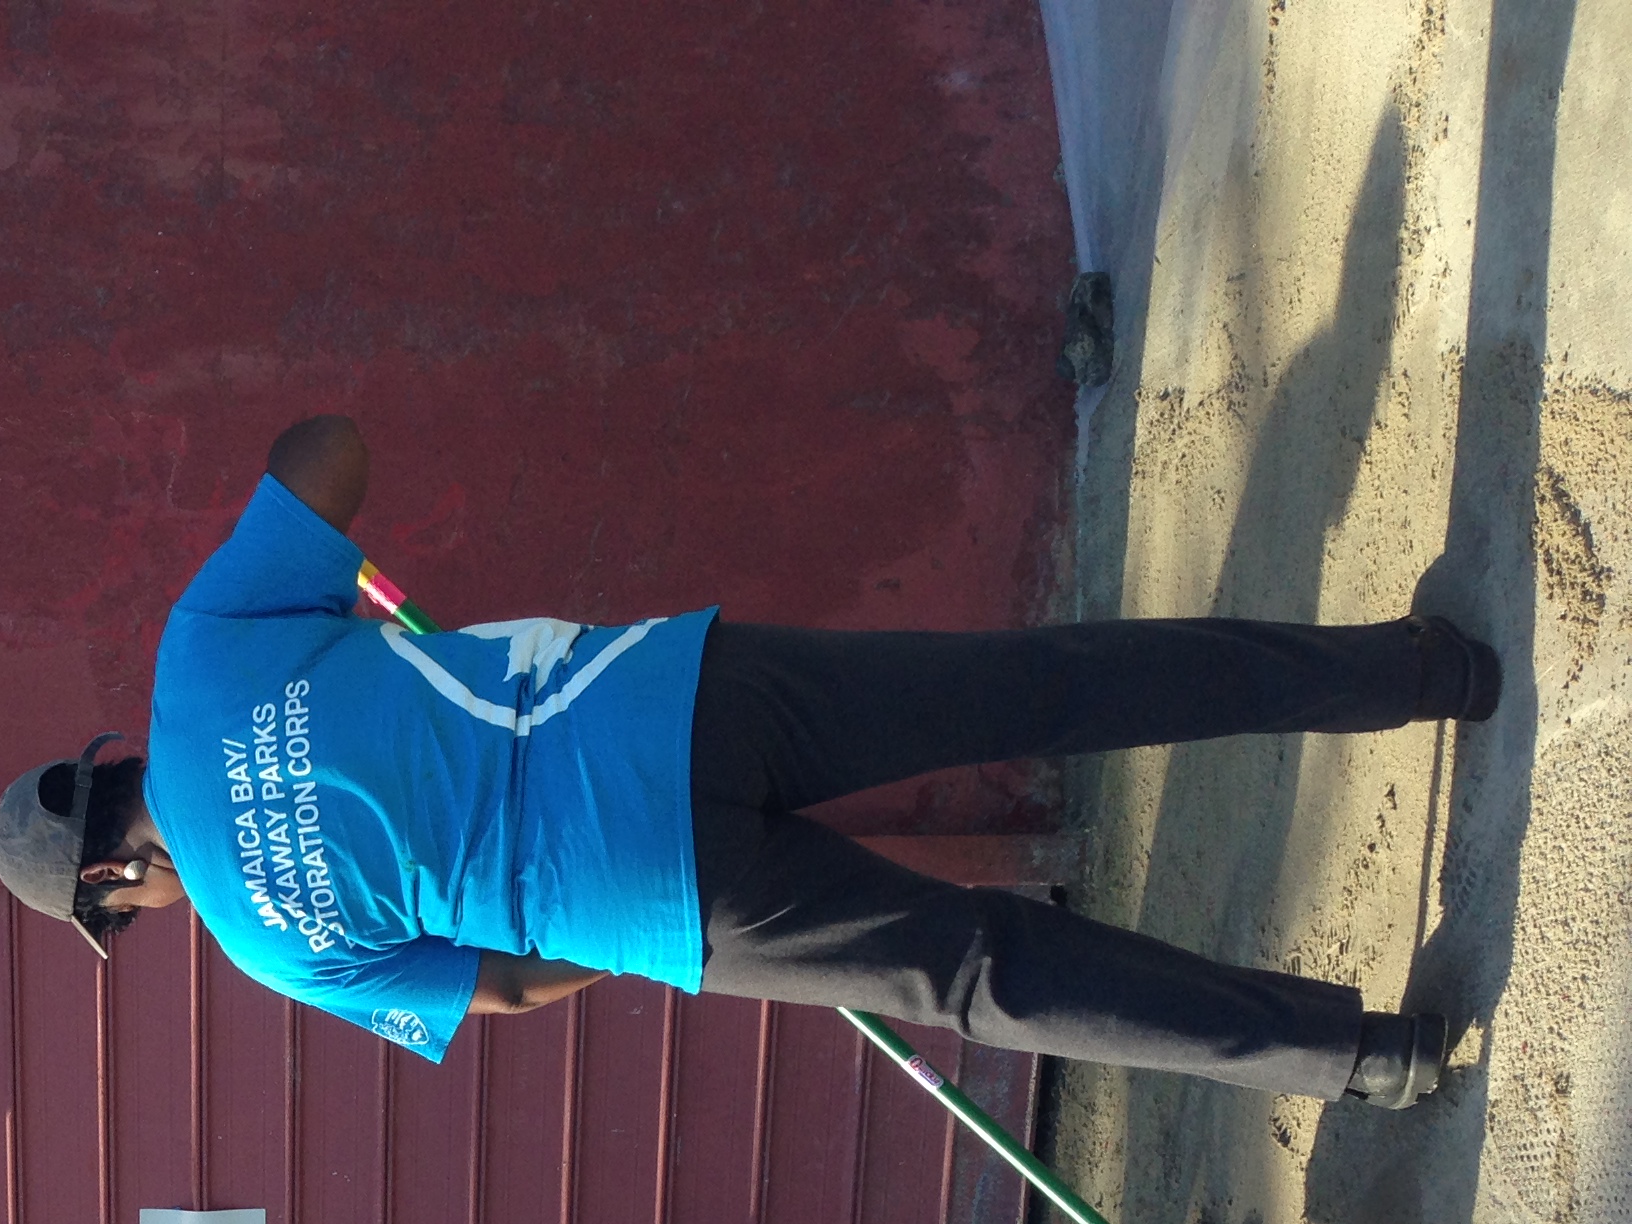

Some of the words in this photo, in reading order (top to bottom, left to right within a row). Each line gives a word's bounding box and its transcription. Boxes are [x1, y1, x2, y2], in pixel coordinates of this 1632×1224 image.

[222, 737, 254, 803] BAY/
[252, 702, 285, 801] PARKS
[284, 679, 312, 777] CORPS
[235, 807, 287, 932] JAMAICA
